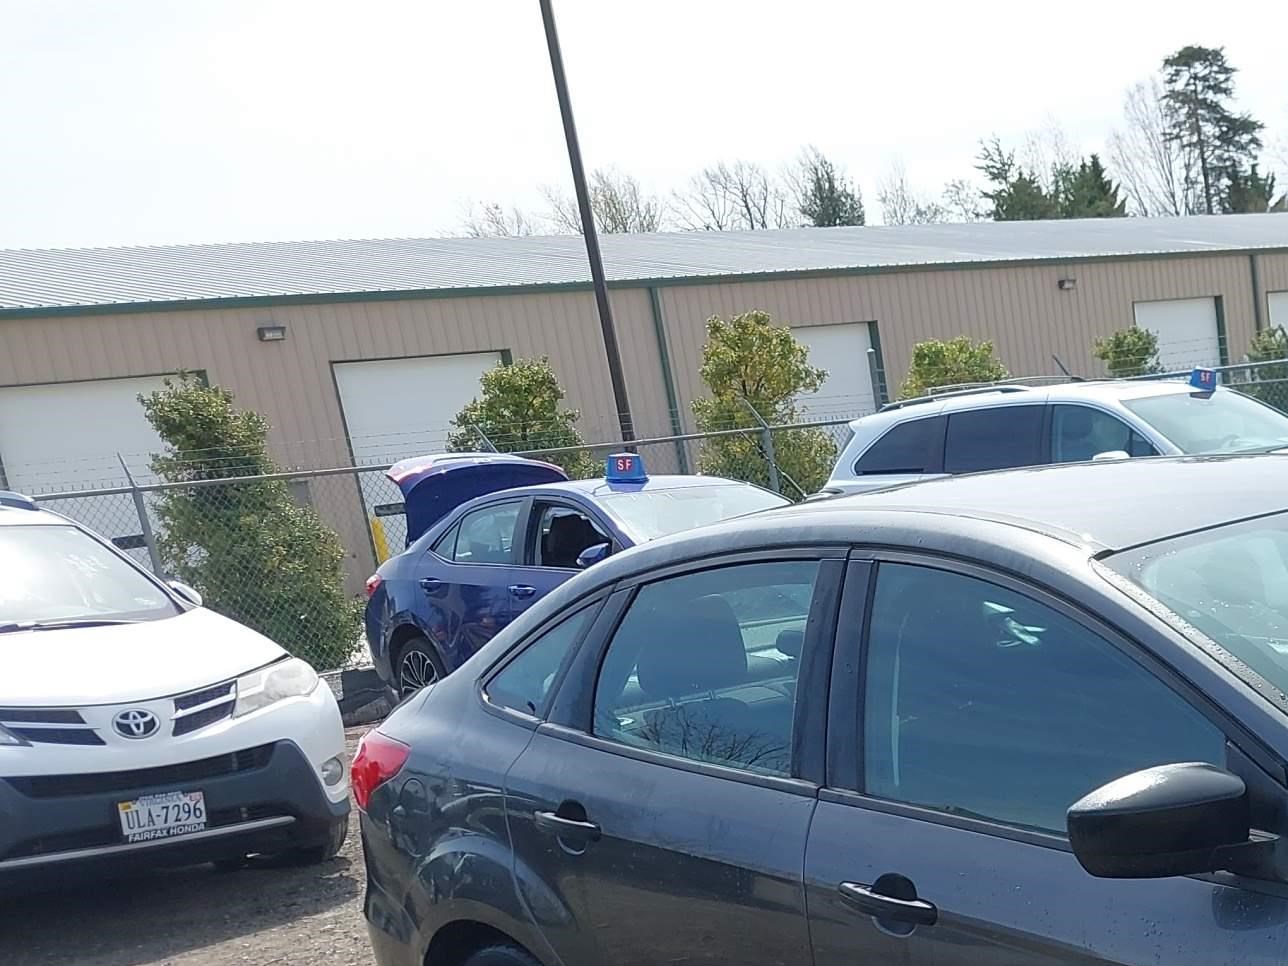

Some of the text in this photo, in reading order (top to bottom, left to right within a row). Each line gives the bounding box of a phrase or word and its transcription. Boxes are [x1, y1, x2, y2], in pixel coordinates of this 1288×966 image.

[617, 459, 632, 471] SF
[125, 800, 203, 830] ULA-7296
[128, 823, 205, 843] FAIRFAX HONDA
